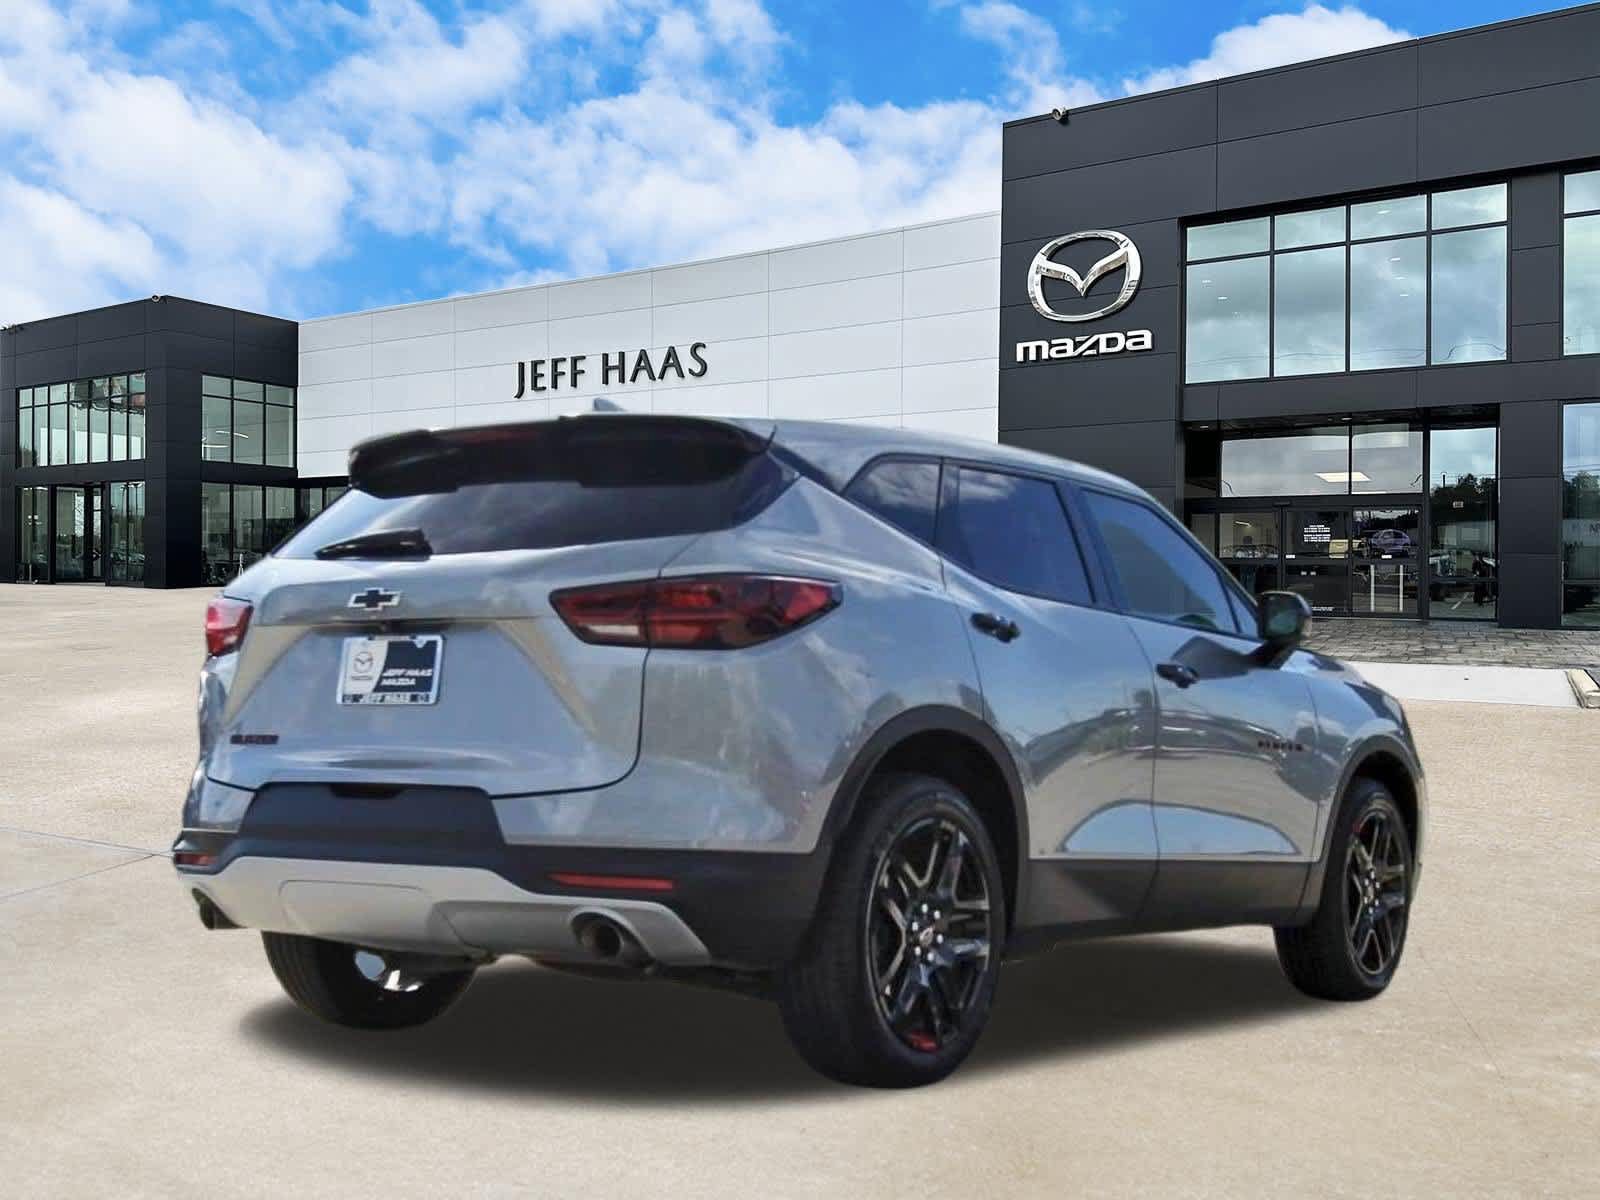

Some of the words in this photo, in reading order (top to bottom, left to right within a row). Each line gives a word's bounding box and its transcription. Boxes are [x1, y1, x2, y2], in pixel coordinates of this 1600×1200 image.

[1016, 329, 1152, 362] mazda
[514, 356, 586, 399] JEFF
[601, 342, 708, 385] HAAS
